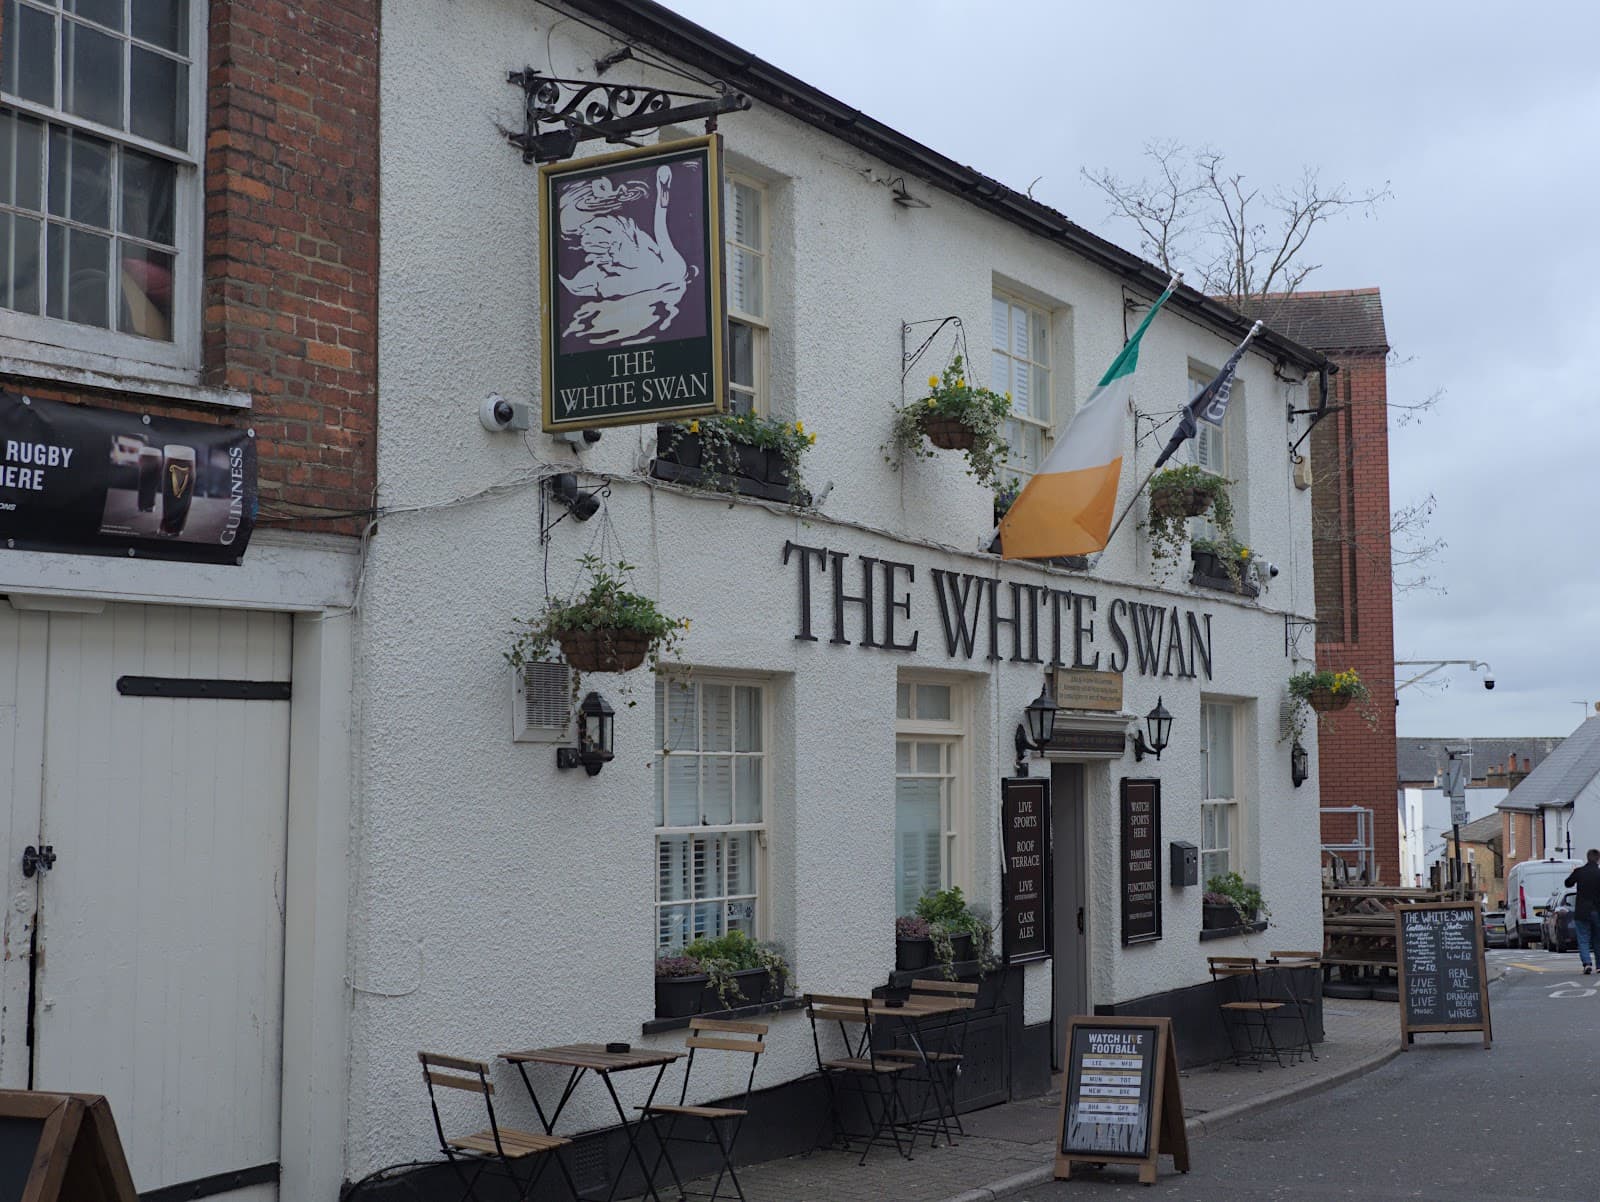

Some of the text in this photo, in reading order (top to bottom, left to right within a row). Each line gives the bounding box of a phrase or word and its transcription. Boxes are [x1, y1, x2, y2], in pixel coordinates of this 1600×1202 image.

[608, 350, 656, 378] THE
[560, 372, 708, 412] WHITE SWAN
[5, 439, 73, 468] RUGBY
[219, 447, 243, 546] GUINNESS
[783, 540, 1213, 681] THE WHITE SWAN
[1019, 801, 1033, 813] LIVE
[1131, 801, 1150, 812] WATCH
[1014, 815, 1037, 829] SPORTS
[1131, 814, 1150, 826] SPORTS
[1134, 827, 1147, 838] HERE
[1017, 839, 1035, 853] ROOF
[1011, 854, 1040, 869] TERRACE
[1020, 879, 1034, 893] LIVE
[1128, 880, 1155, 894] FUNCTIONS
[1018, 911, 1035, 924] CASK
[1404, 910, 1474, 924] THE WHITE SWAN
[1019, 925, 1034, 939] ALES
[1449, 968, 1473, 979] REAL
[1411, 978, 1437, 988] LIVE
[1453, 978, 1470, 989] ALE
[1411, 987, 1438, 996] SPORTS
[1447, 992, 1480, 1001] DRAUGHT
[1412, 996, 1437, 1007] LIVE
[1449, 1009, 1477, 1019] WINES
[1088, 1033, 1121, 1044] WATCH
[1091, 1043, 1138, 1054] FOOTBALL
